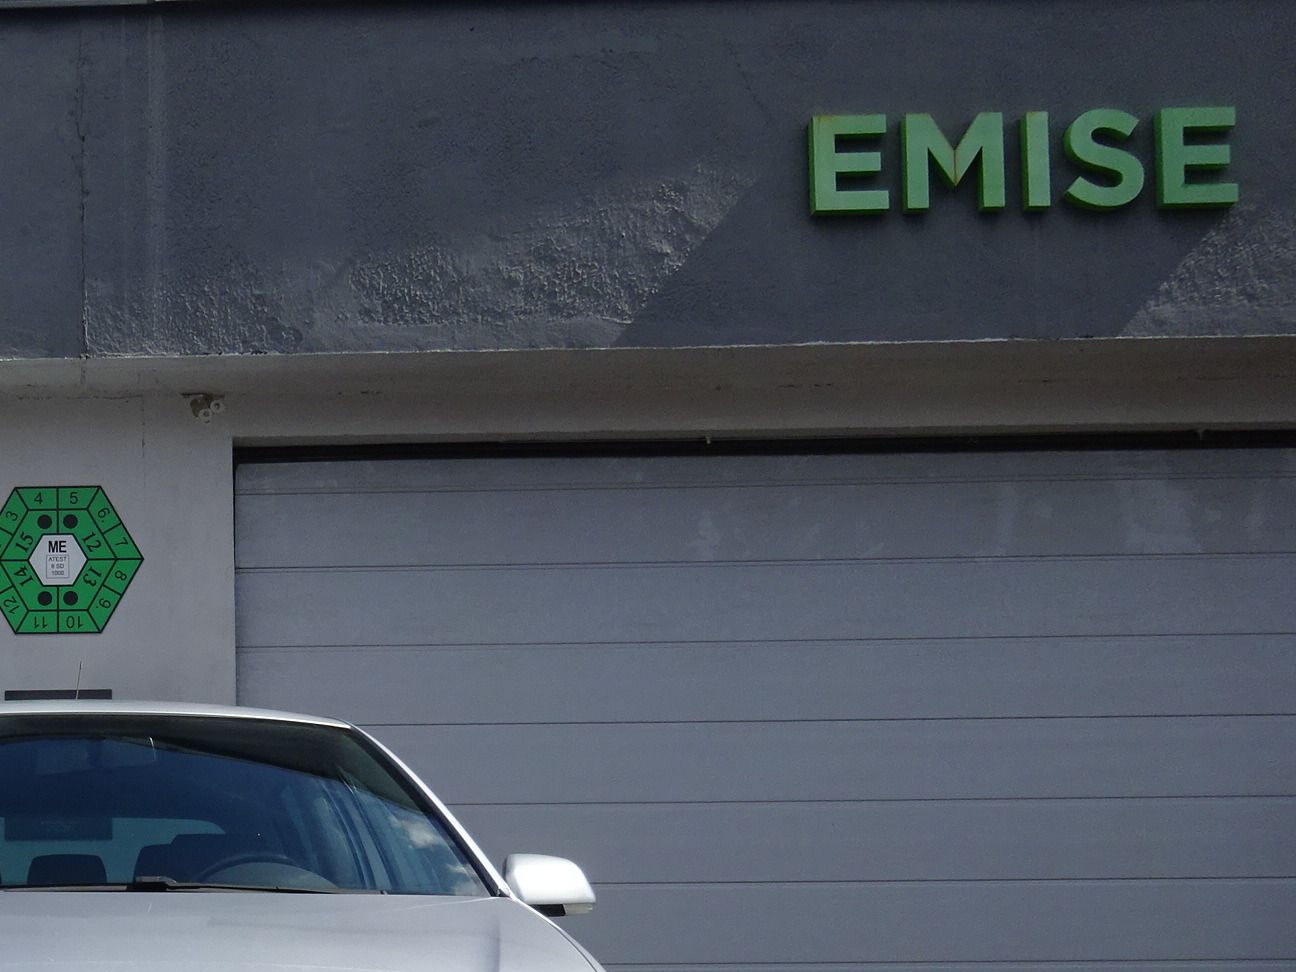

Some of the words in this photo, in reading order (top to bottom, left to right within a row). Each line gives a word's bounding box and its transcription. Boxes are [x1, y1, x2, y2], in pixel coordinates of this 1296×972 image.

[809, 106, 1239, 216] EMISE
[34, 492, 43, 504] 4
[69, 491, 79, 504] 5
[5, 510, 18, 522] 3
[15, 531, 34, 553] 15
[48, 540, 67, 553] ME
[82, 531, 102, 552] 12
[114, 539, 129, 548] 7
[13, 565, 35, 587] 14
[82, 565, 103, 588] 13
[114, 569, 128, 582] 8
[3, 595, 21, 615] 12
[65, 615, 83, 629] 10
